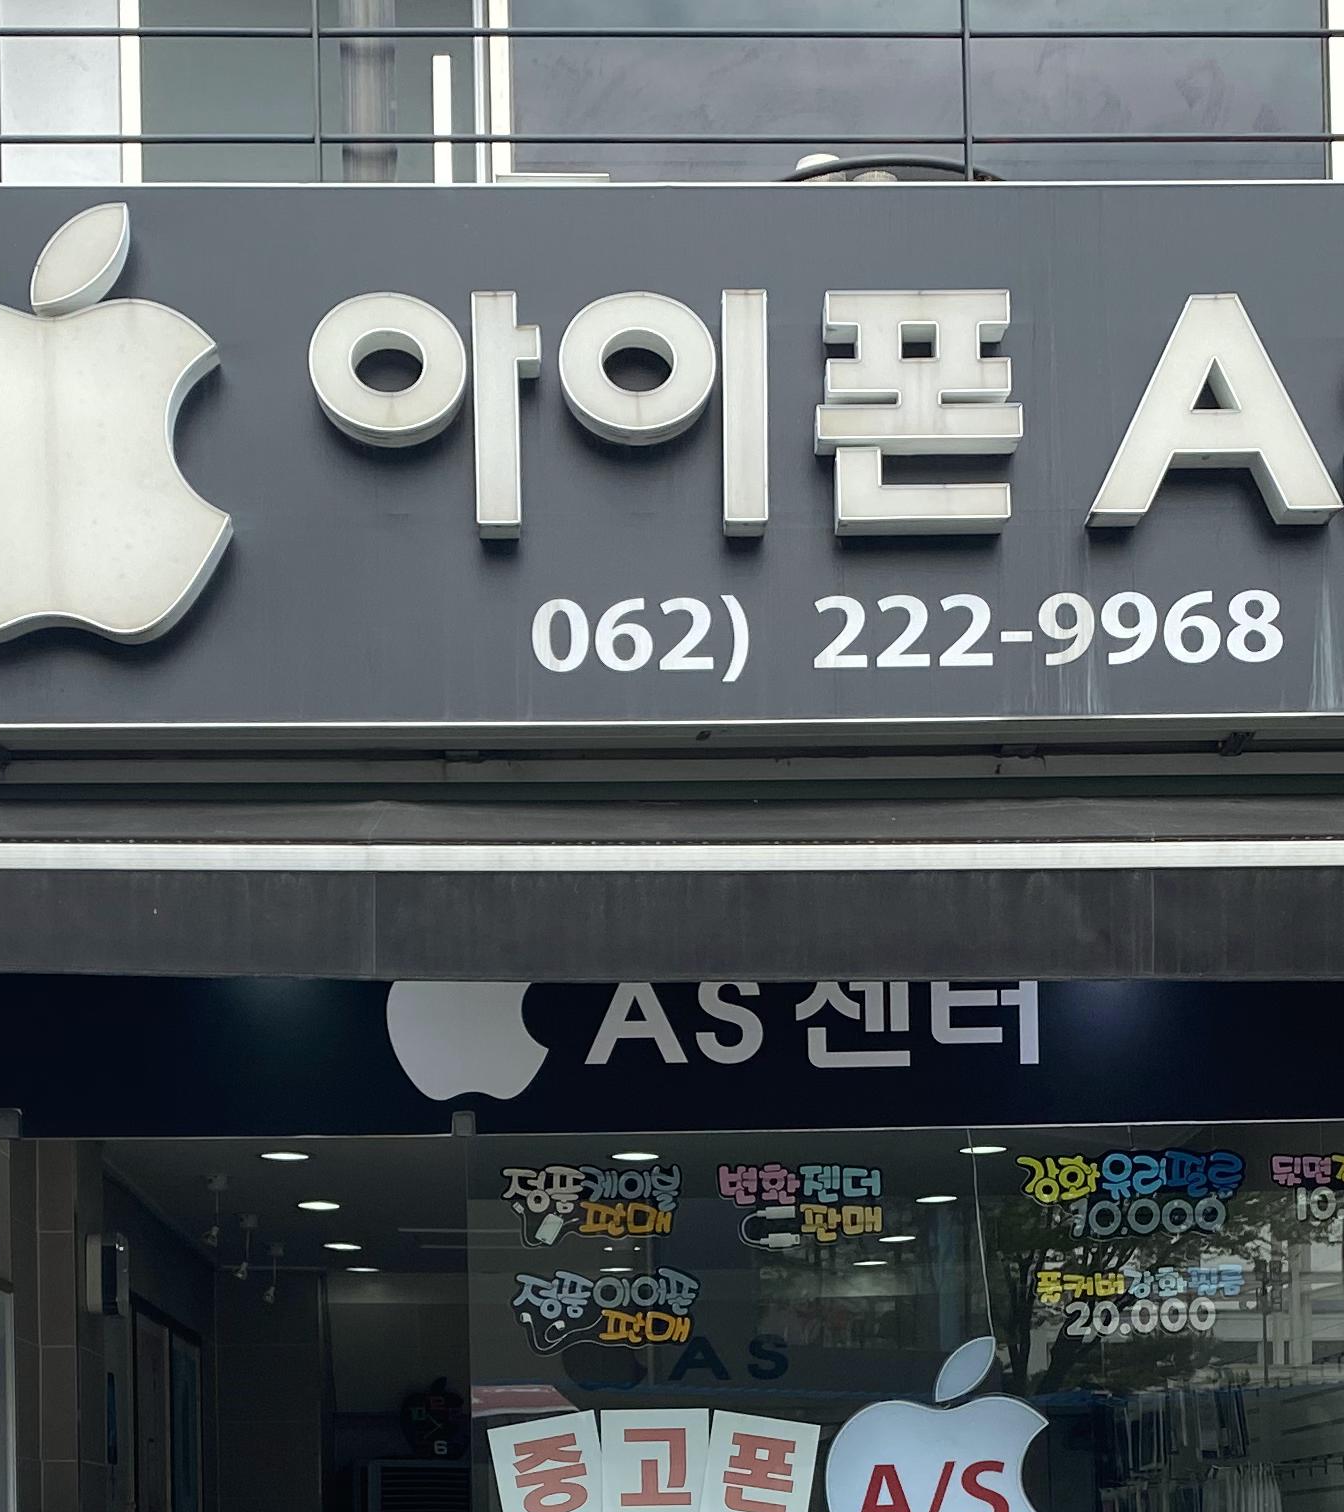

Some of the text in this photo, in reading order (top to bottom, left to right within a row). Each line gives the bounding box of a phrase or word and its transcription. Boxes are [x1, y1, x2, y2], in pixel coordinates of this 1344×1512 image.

[309, 288, 1023, 540] 아이폰
[531, 589, 1285, 683] 062) 222-9968
[584, 980, 1040, 1069] AS 센터
[501, 1164, 681, 1214] 정품케이블
[718, 1164, 882, 1207] 변환젠더
[1016, 1150, 1245, 1204] 강화유리필름
[578, 1201, 672, 1237] 판매
[799, 1204, 883, 1243] 판매
[513, 1267, 700, 1321] 정품이어폰
[599, 1310, 692, 1344] 판매
